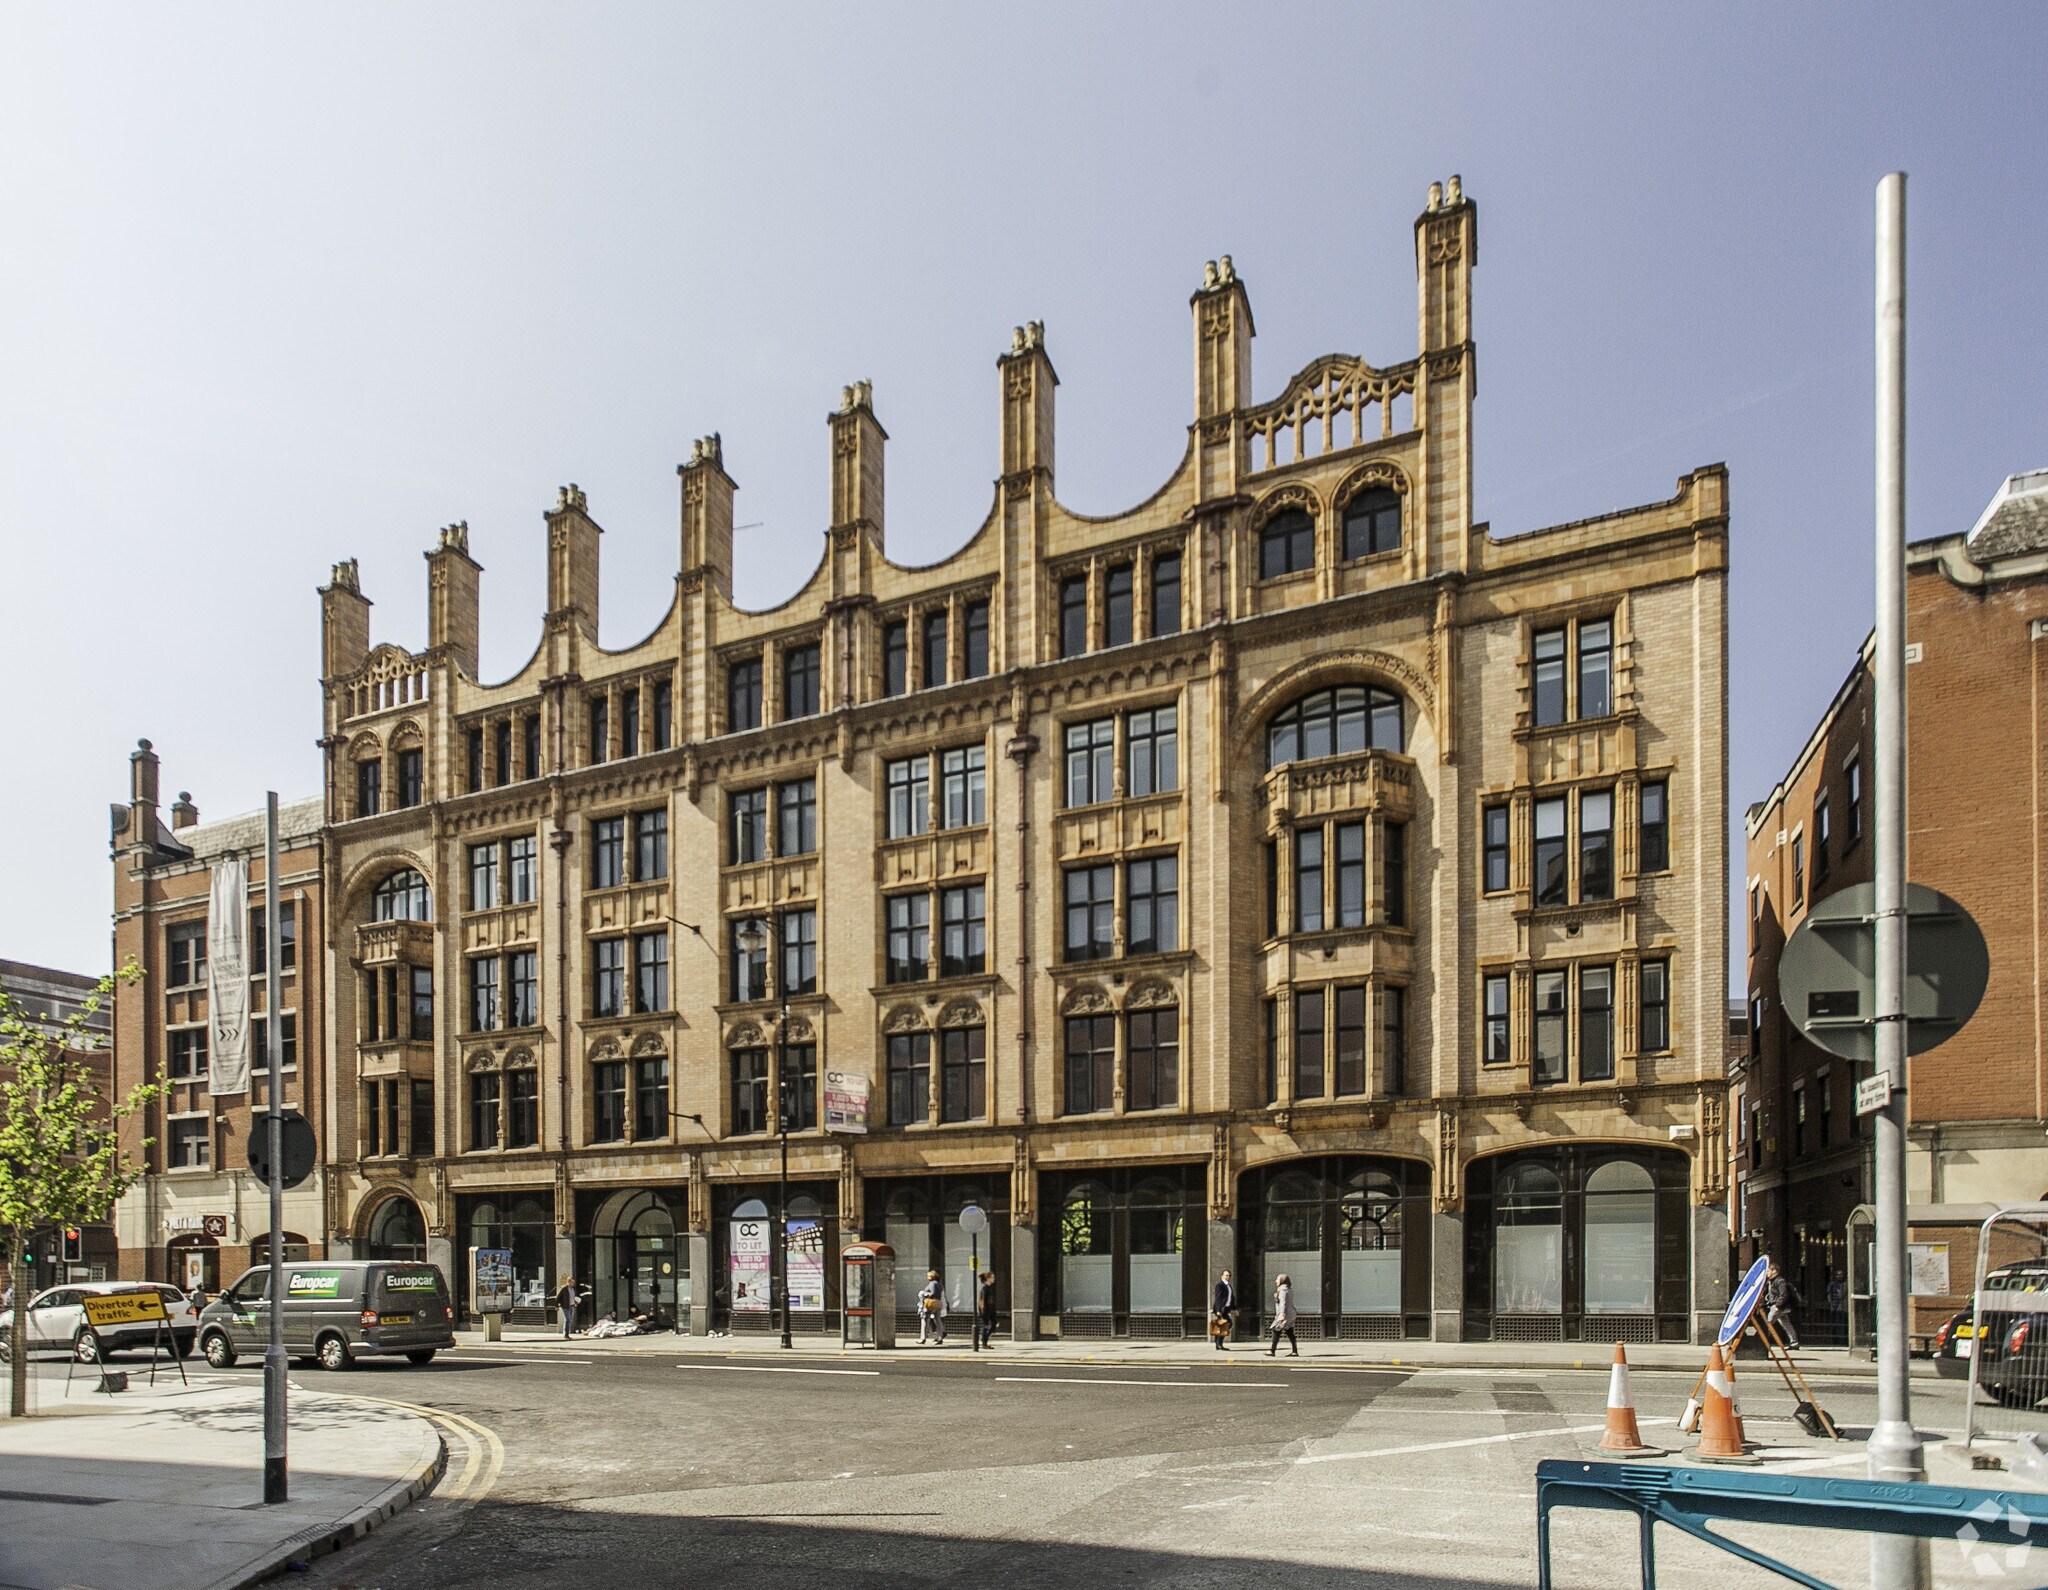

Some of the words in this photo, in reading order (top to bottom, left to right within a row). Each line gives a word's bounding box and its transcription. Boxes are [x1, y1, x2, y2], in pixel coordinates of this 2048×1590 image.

[1867, 1079, 1886, 1092] loading
[737, 1242, 748, 1250] TO
[750, 1242, 762, 1250] LET
[289, 1274, 339, 1293] Europcar
[386, 1275, 434, 1288] Europcar
[88, 1299, 134, 1311] Diverted
[97, 1309, 131, 1320] traffic
